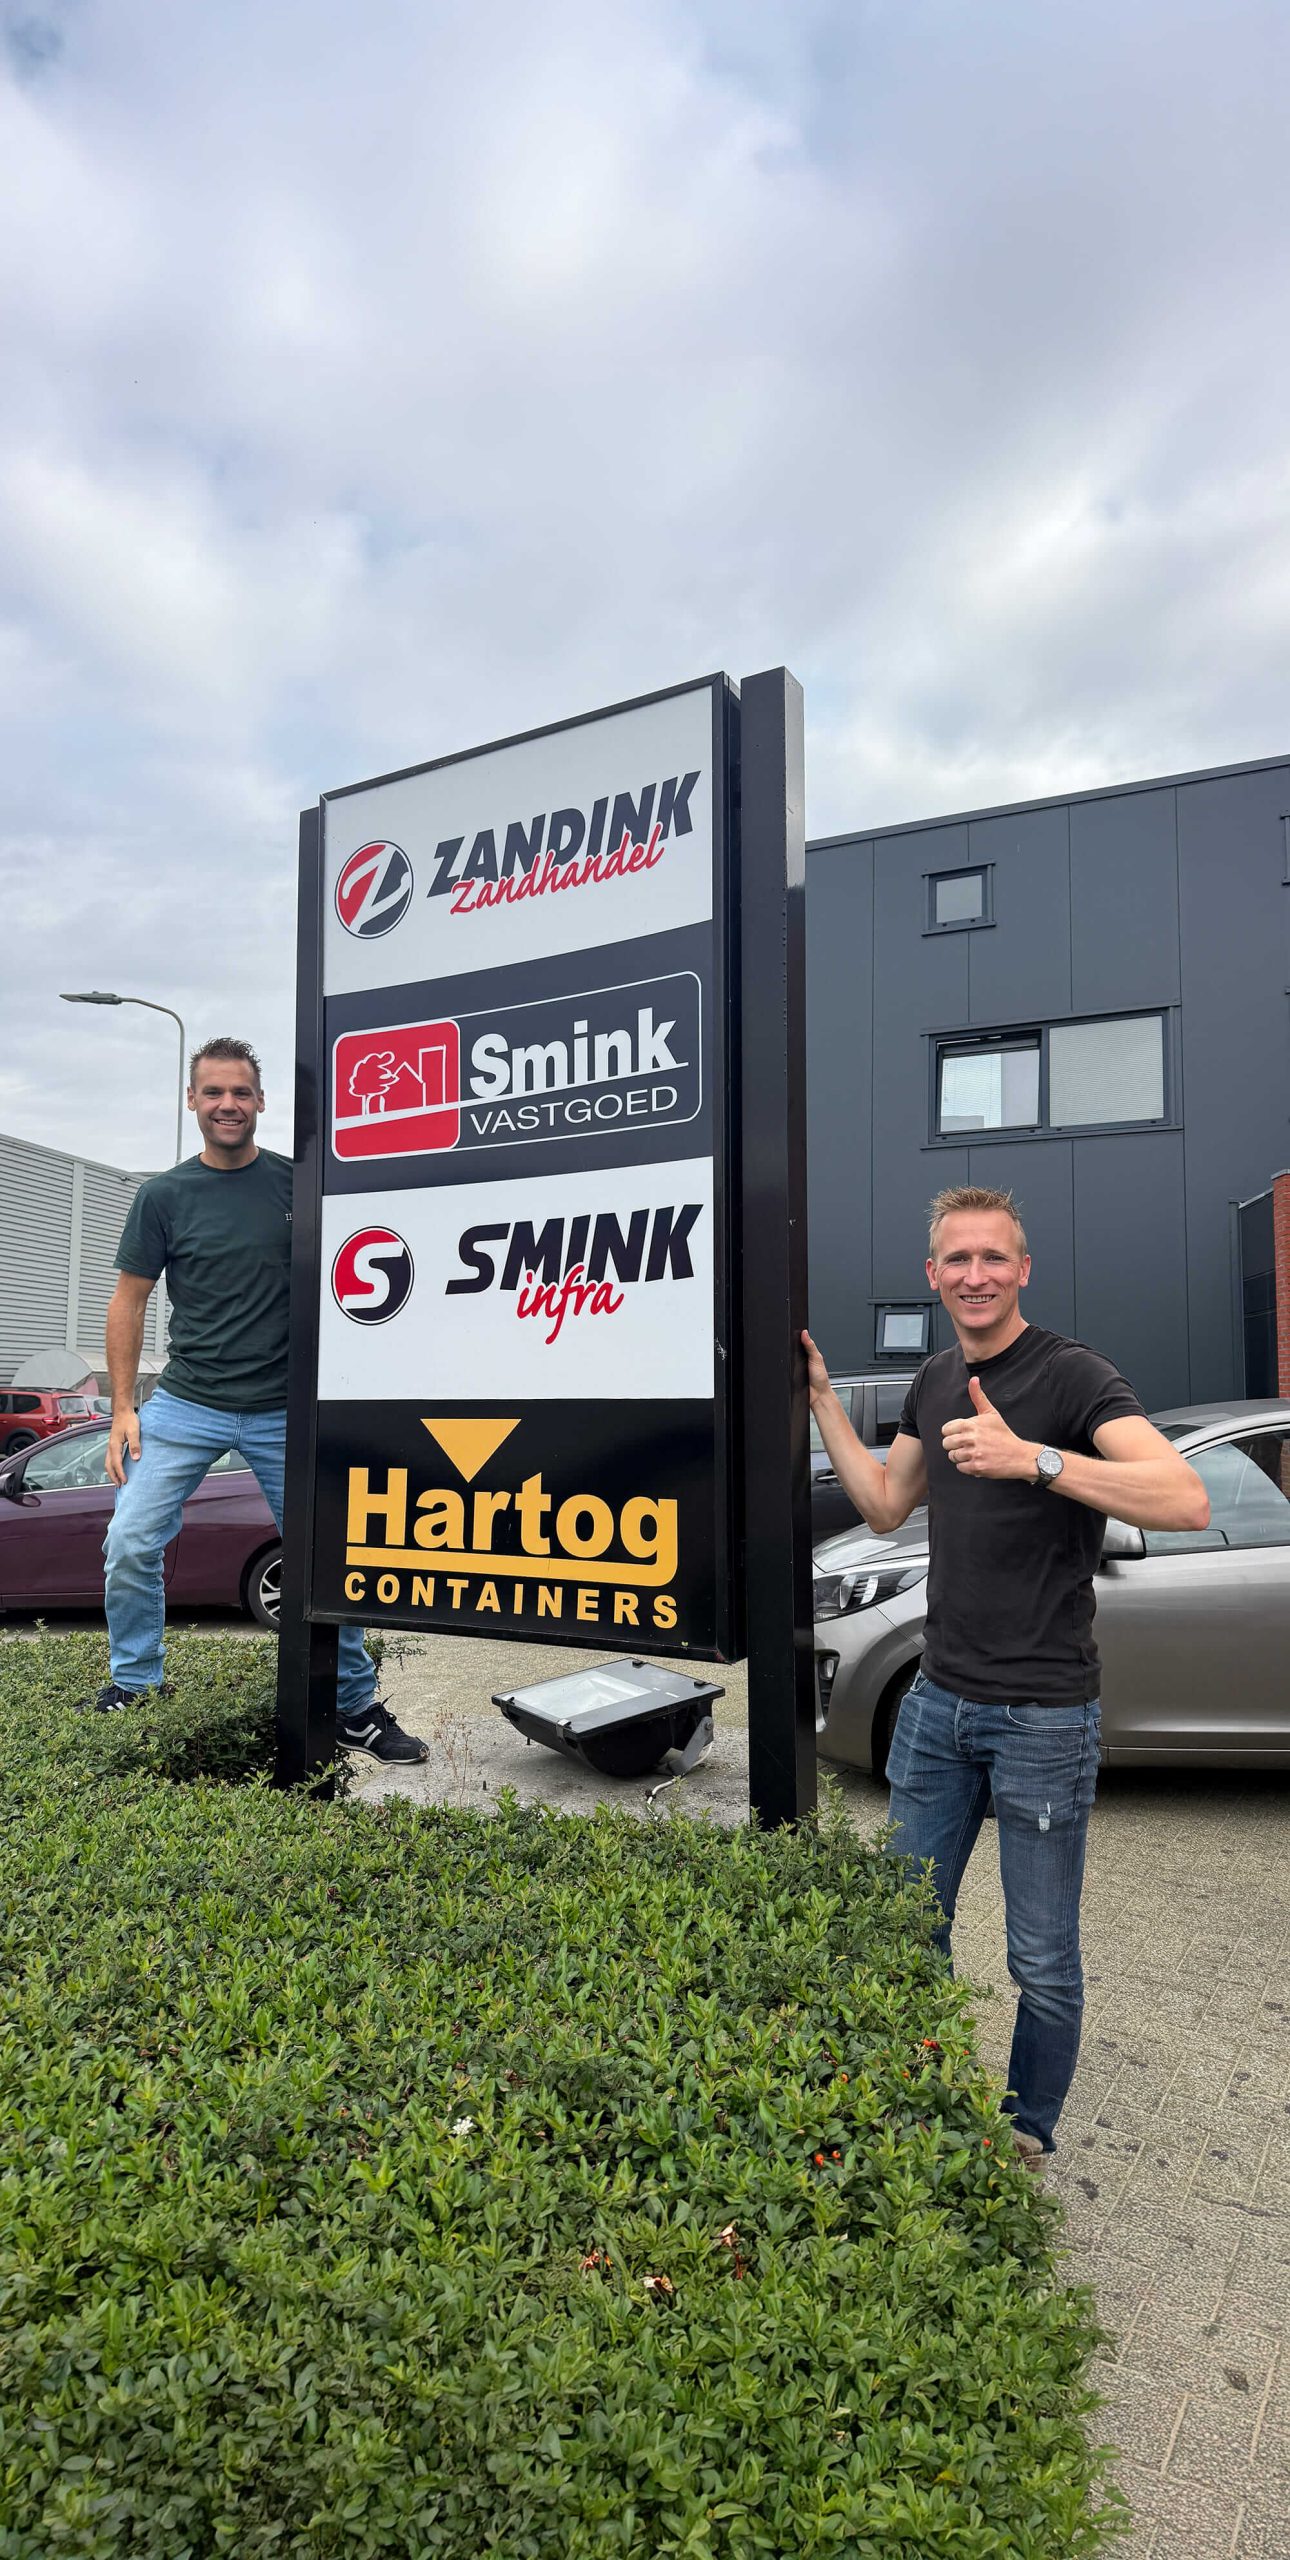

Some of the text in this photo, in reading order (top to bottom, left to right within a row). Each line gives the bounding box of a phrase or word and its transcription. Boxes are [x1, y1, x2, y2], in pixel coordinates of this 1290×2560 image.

[427, 771, 701, 898] ZANDINK
[451, 825, 664, 914] Zandhandel
[470, 1008, 680, 1098] Smink
[471, 1086, 678, 1135] VASTGOED
[445, 1204, 703, 1295] SMINK
[517, 1265, 625, 1345] infra
[346, 1467, 678, 1586] Hartog
[344, 1571, 678, 1629] CONTAINERS
